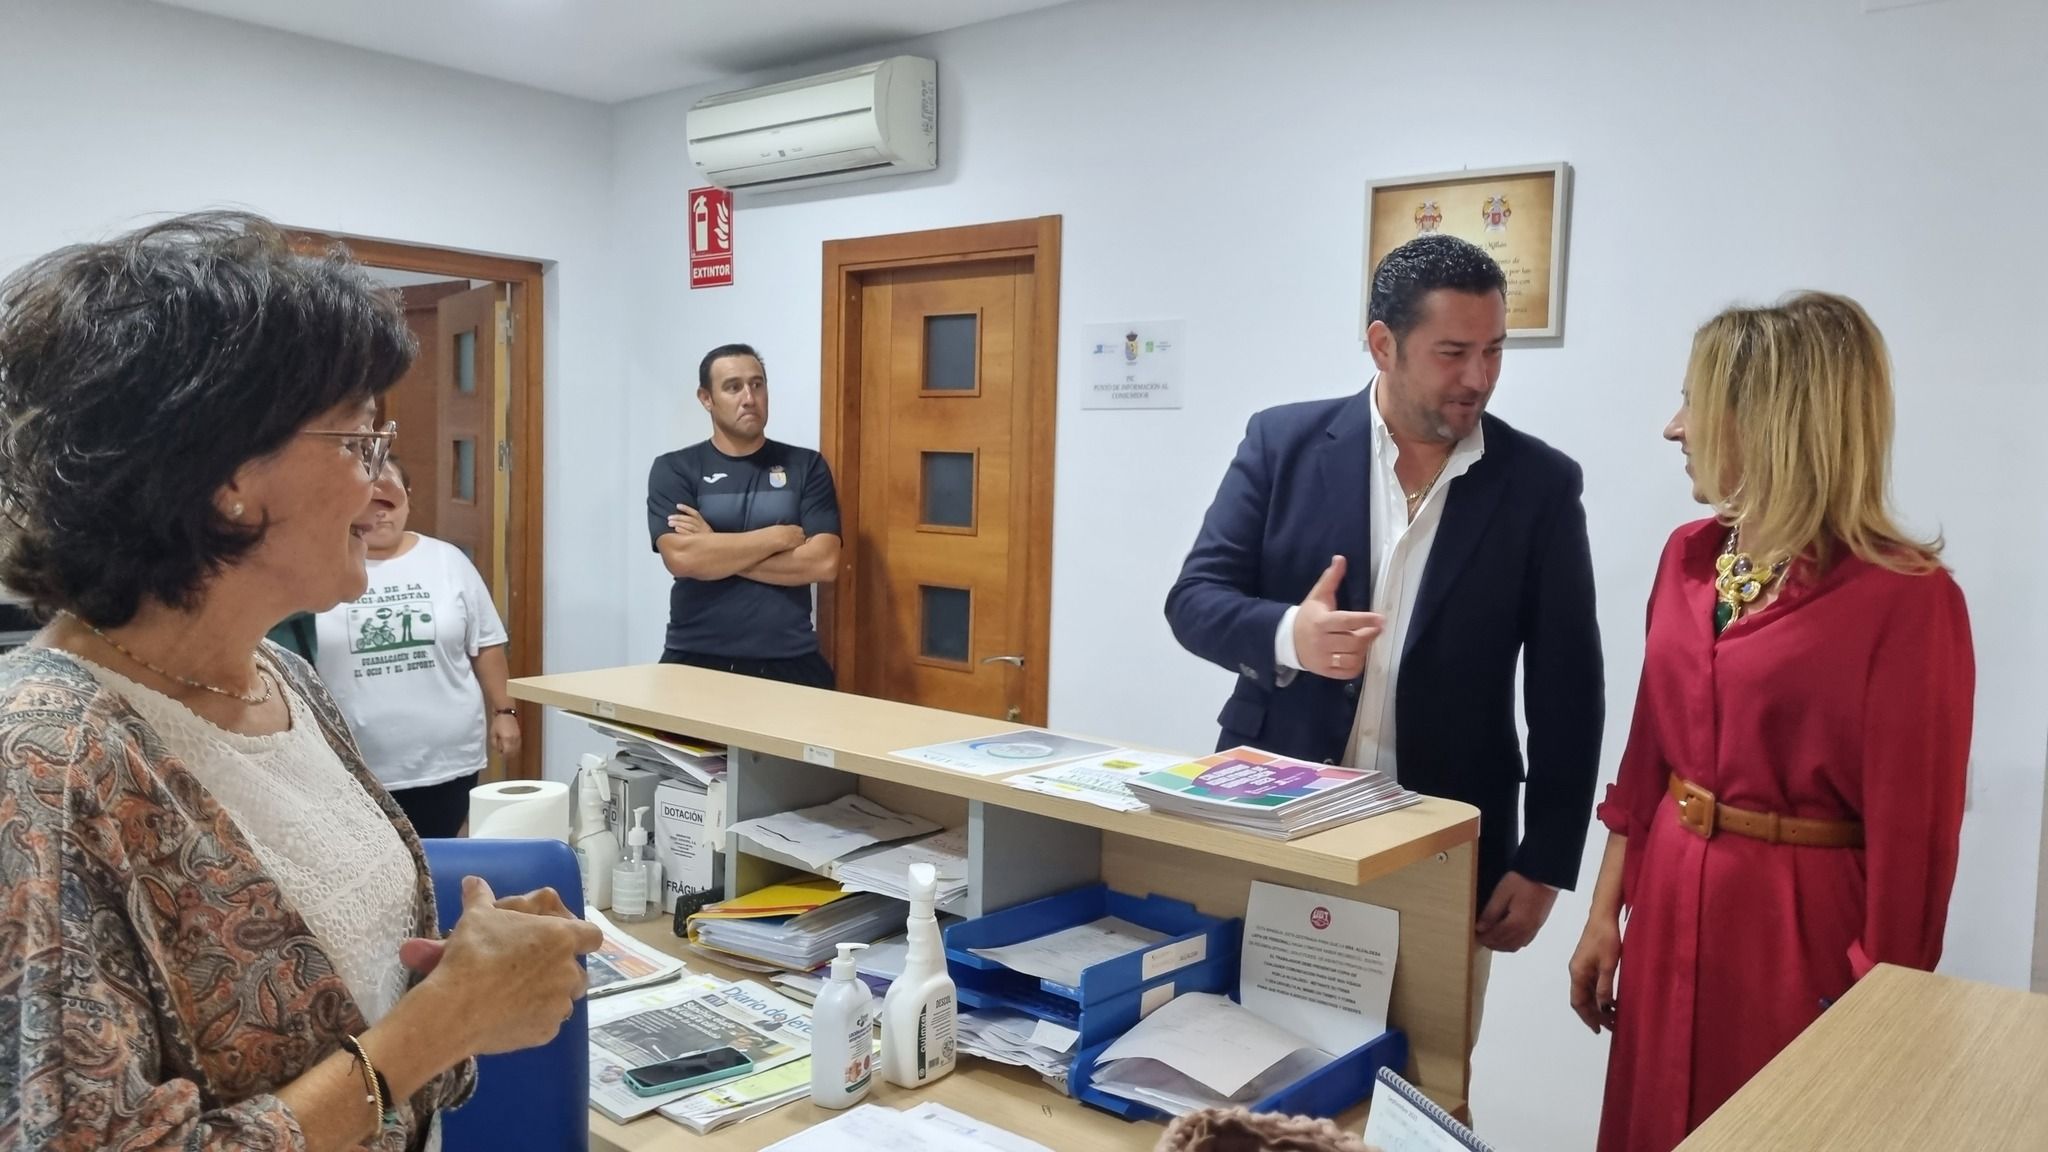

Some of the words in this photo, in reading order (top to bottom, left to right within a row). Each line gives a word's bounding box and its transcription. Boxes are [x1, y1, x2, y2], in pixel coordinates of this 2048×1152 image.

[693, 264, 731, 279] EXTINTOR
[384, 585, 399, 594] DE
[407, 583, 422, 591] LA
[354, 669, 363, 678] EL
[394, 665, 404, 673] EL
[664, 806, 703, 823] DOTACIÓN
[720, 986, 767, 1011] Diario
